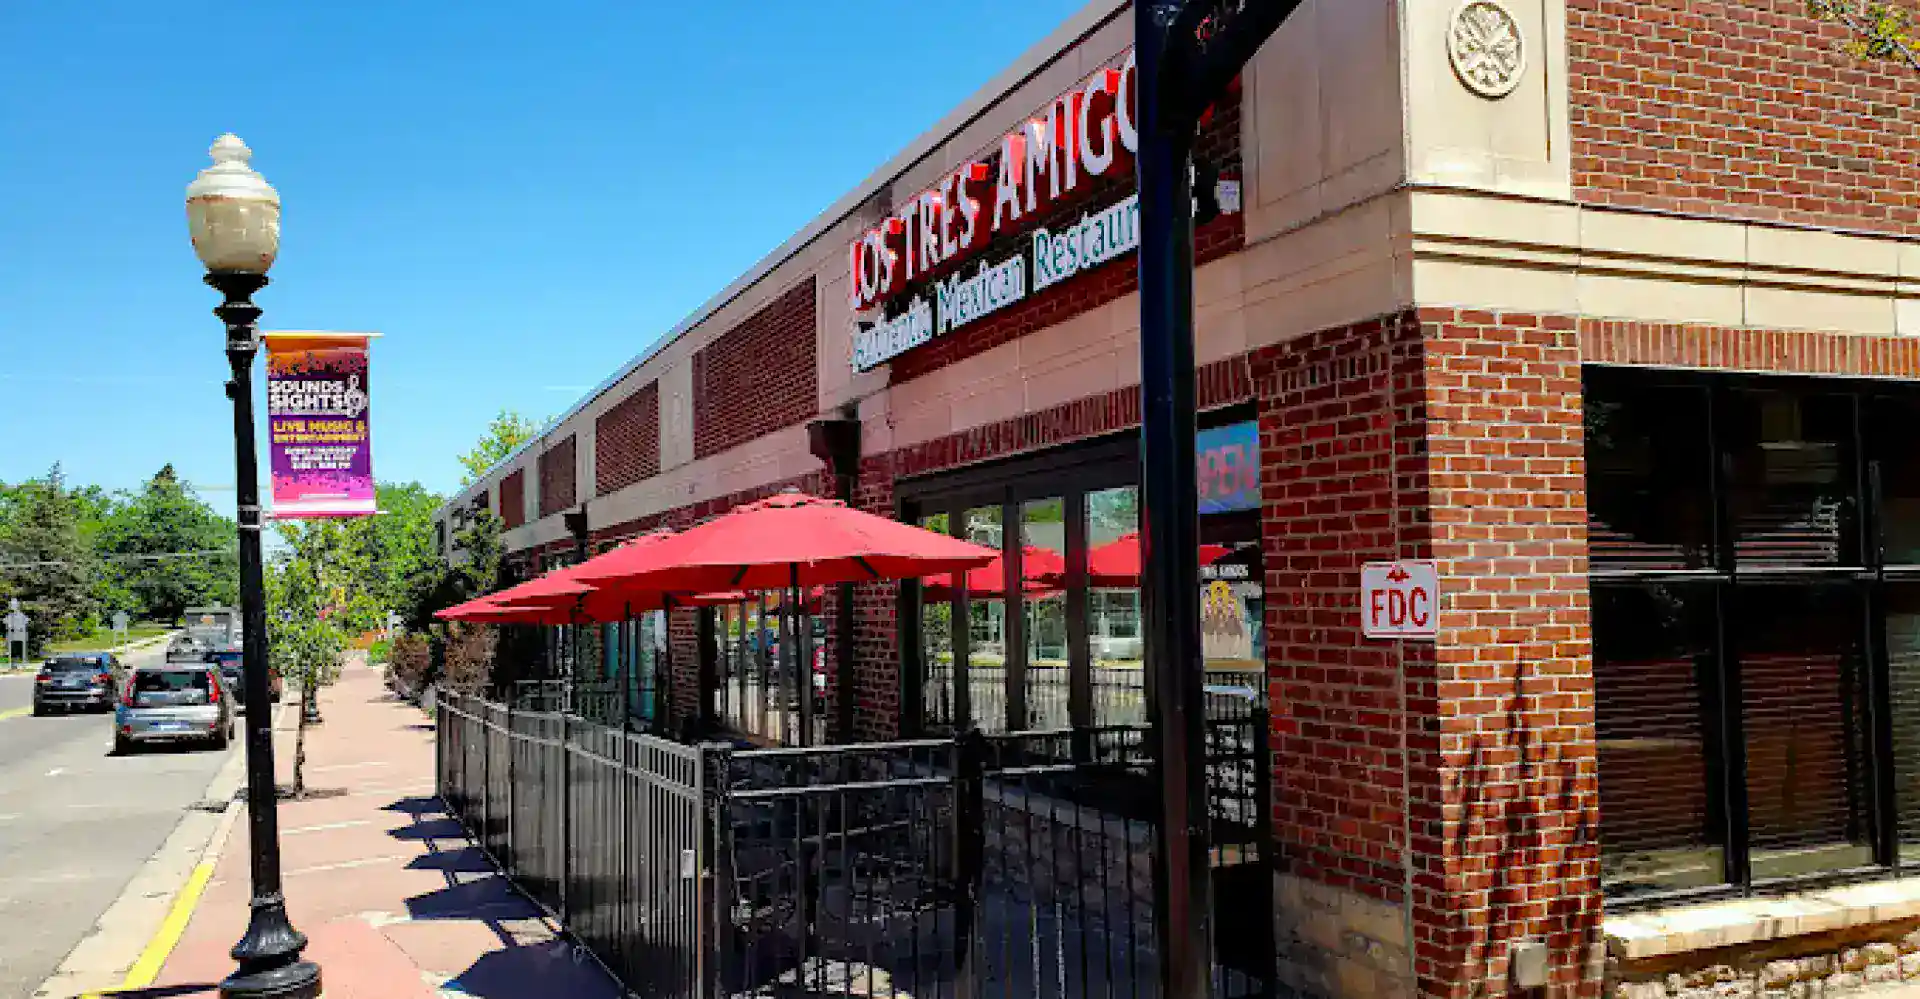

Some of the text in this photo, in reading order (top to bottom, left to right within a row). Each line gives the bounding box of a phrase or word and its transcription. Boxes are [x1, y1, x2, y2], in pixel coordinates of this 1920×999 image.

[850, 50, 1139, 309] LOS TRES AMIGO
[937, 253, 1026, 336] Mexican
[1033, 194, 1140, 292] Restaur
[270, 380, 345, 393] SOUNDS
[270, 394, 345, 408] SIGHTS
[273, 420, 306, 432] LIVE
[309, 420, 353, 432] MUSIC
[1371, 586, 1428, 627] FDC
